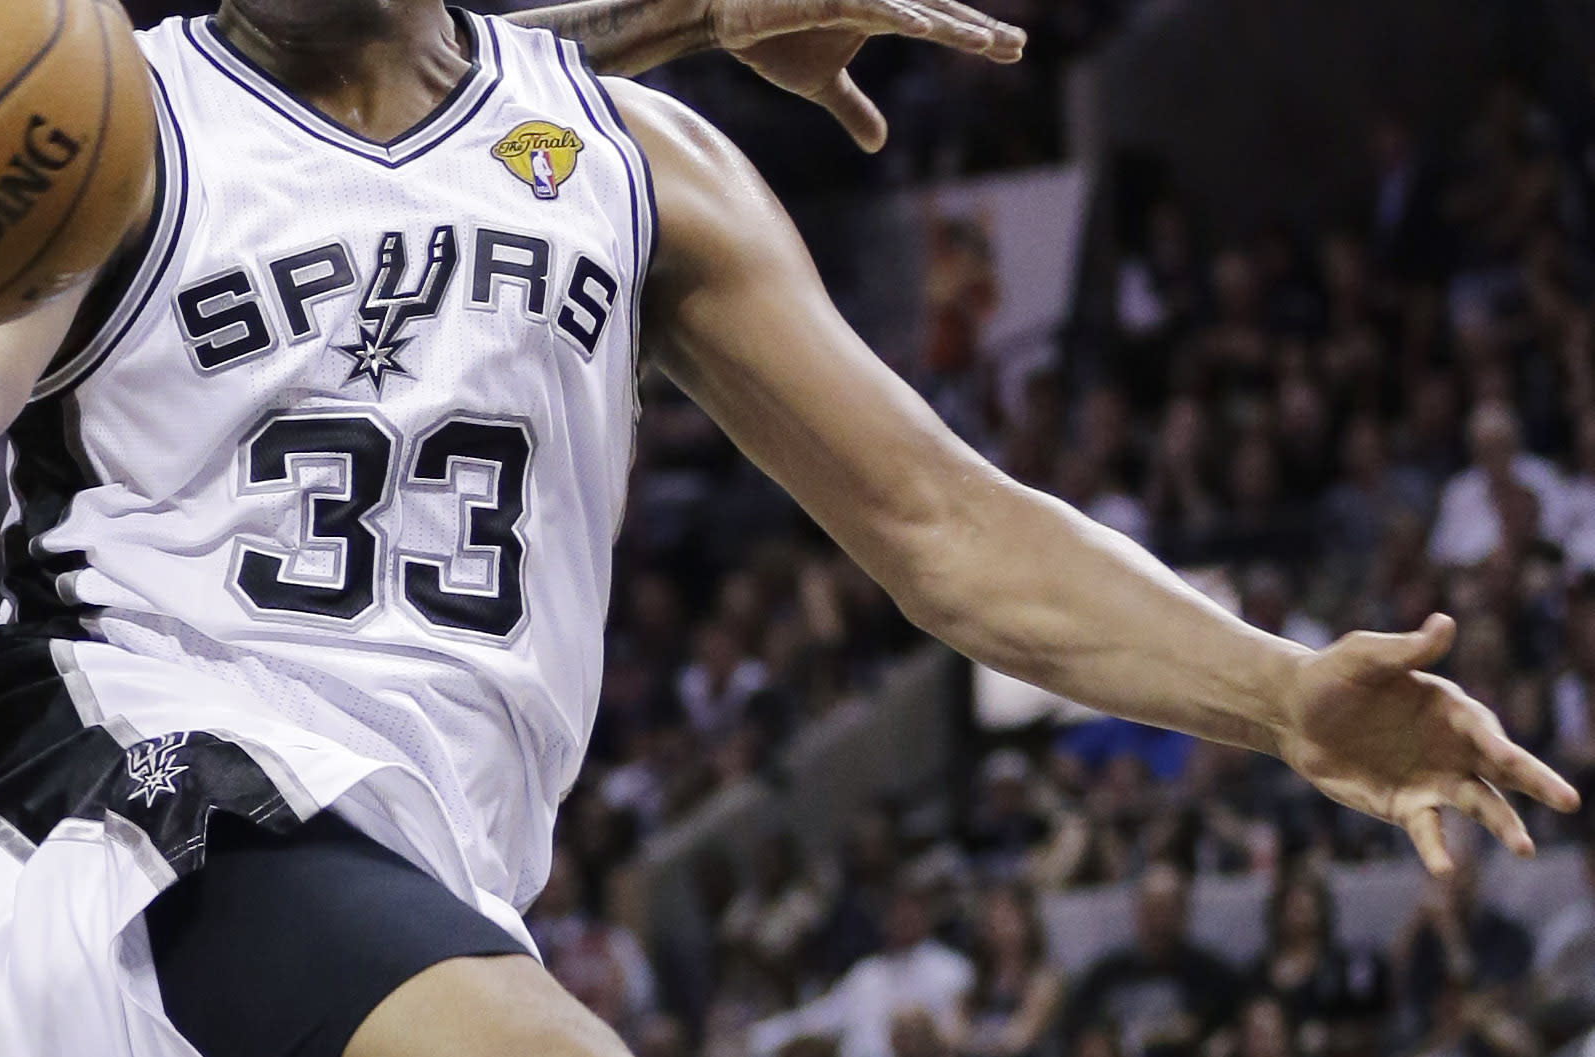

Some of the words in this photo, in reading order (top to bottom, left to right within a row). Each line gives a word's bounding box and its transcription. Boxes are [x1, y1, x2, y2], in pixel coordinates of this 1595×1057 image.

[512, 130, 578, 157] Finals
[174, 224, 622, 390] SPURS
[228, 410, 537, 644] 33
